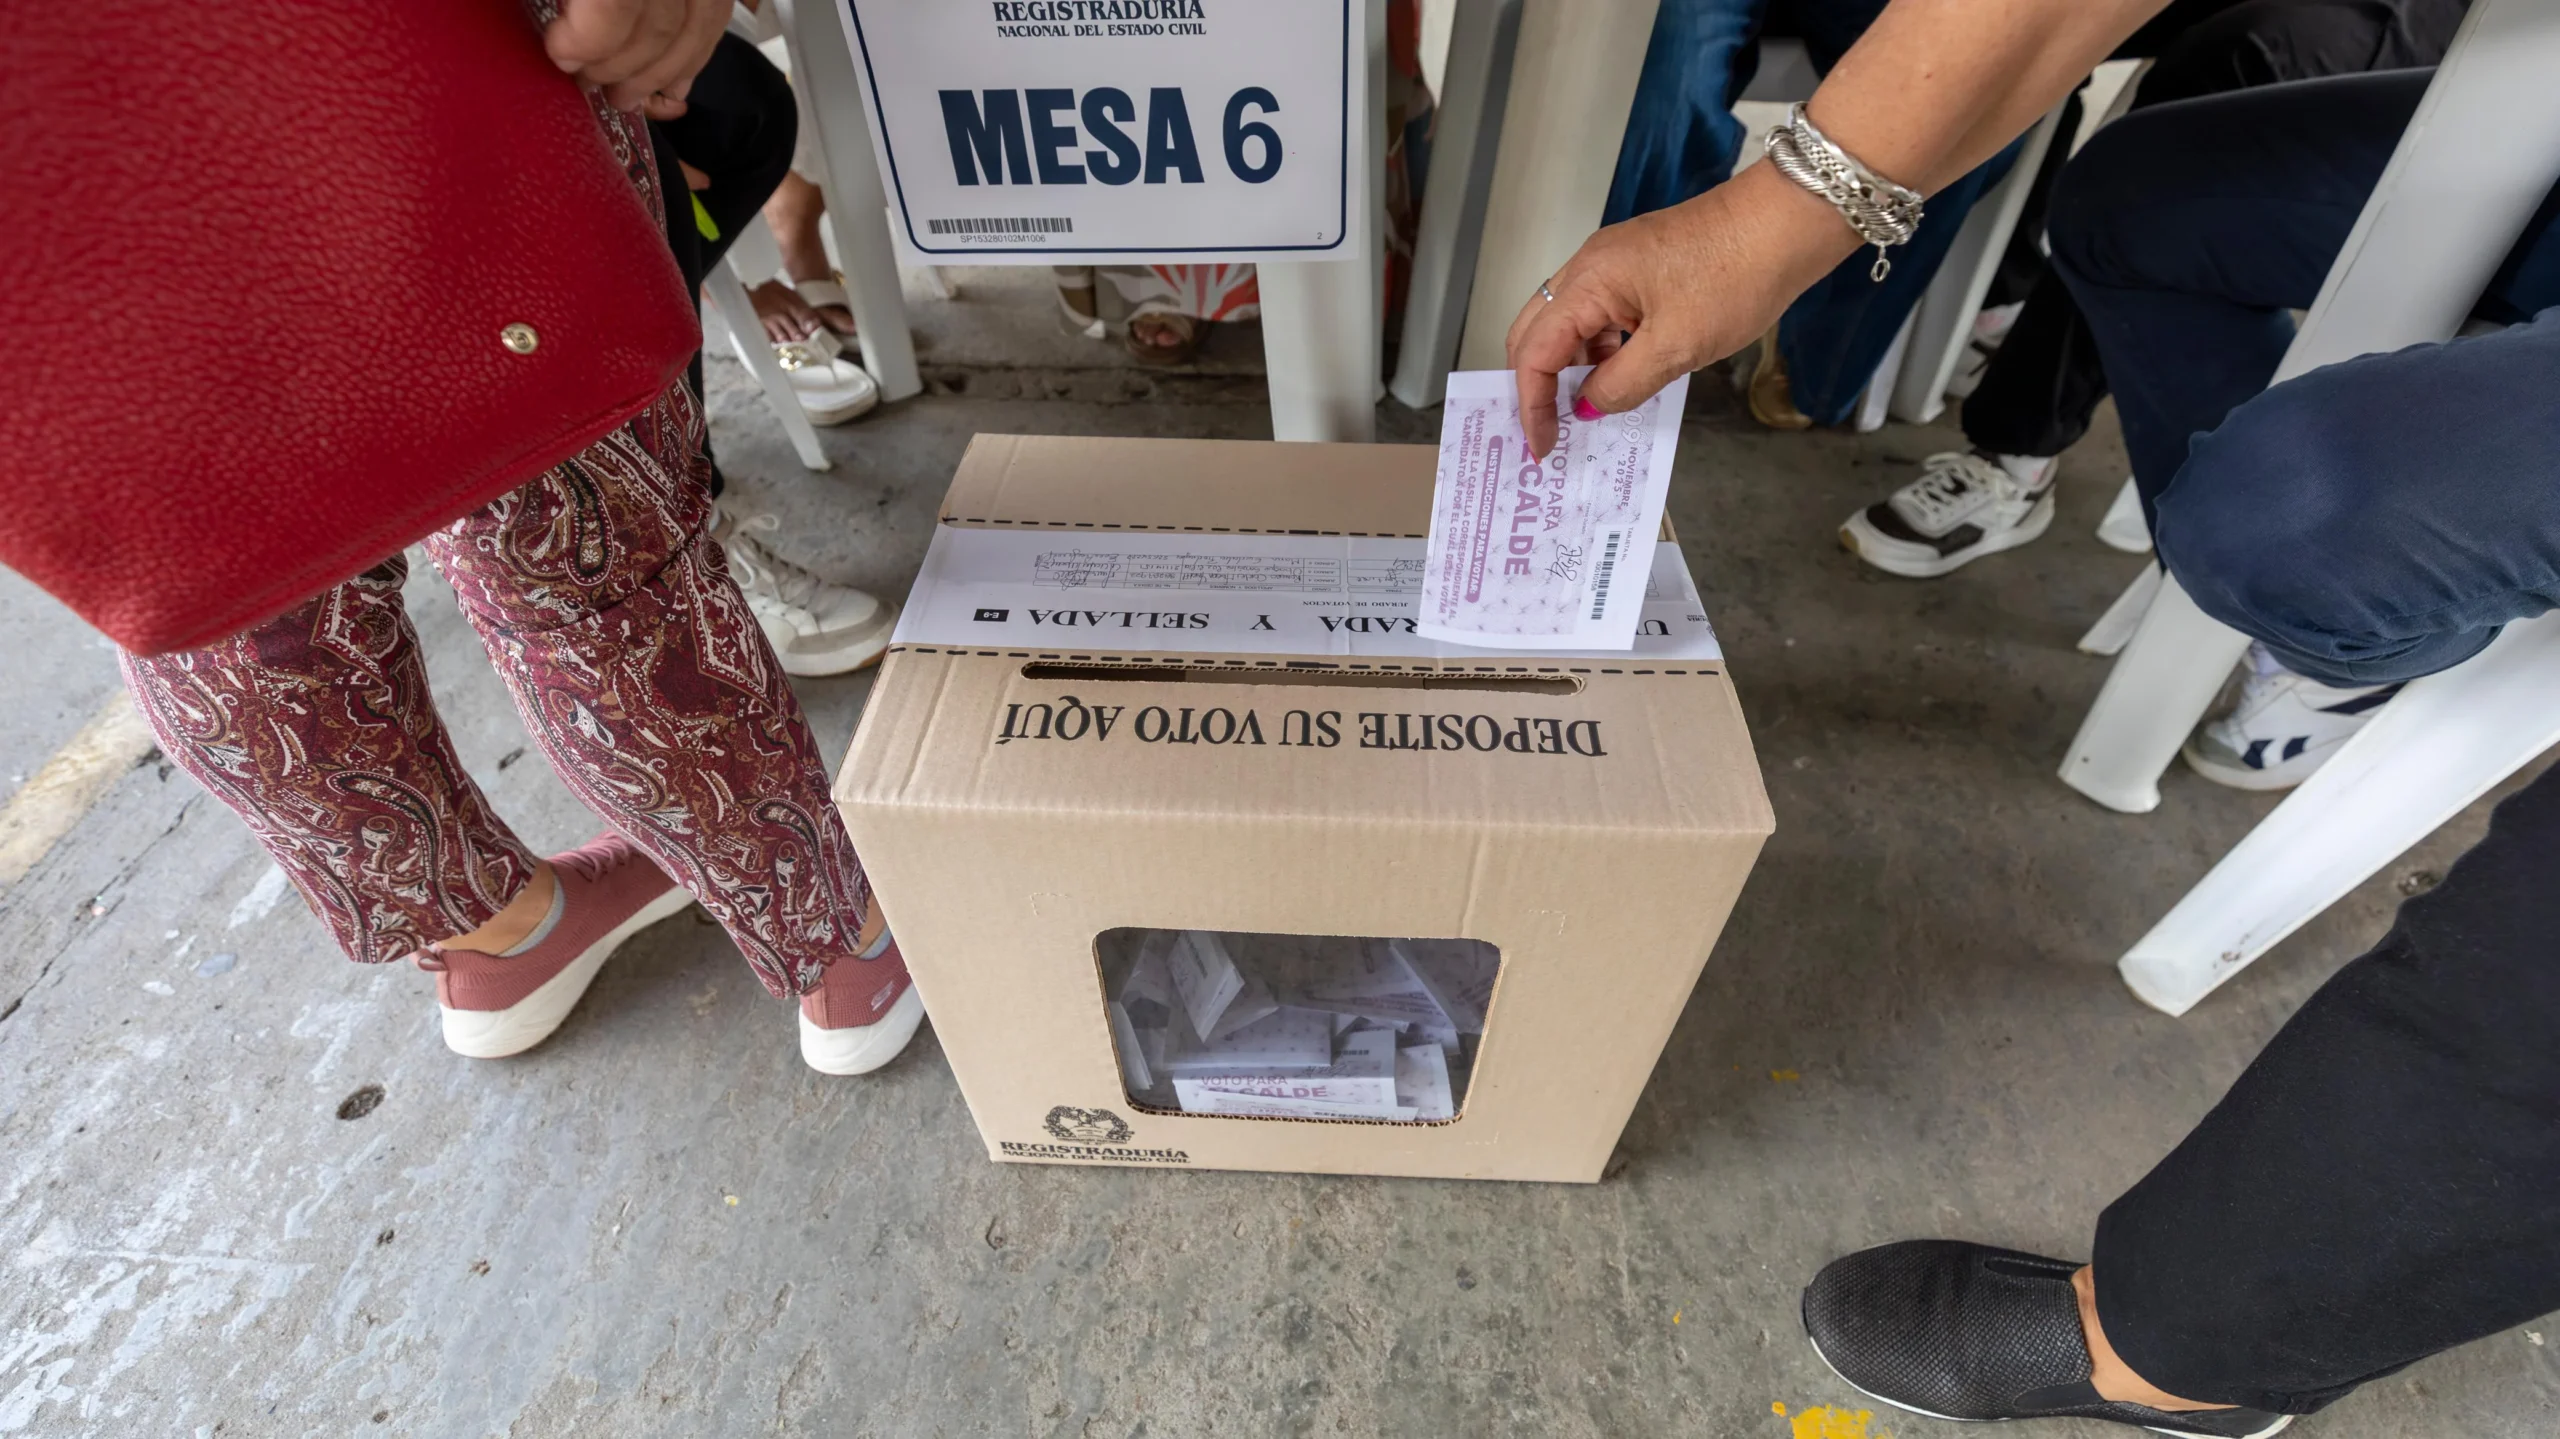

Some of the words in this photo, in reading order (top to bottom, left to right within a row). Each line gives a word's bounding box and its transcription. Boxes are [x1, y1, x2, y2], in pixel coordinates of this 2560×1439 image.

[996, 25, 1070, 38] NACIONAL
[1074, 25, 1104, 37] DEL
[1108, 24, 1164, 36] ESTADO
[1168, 23, 1207, 36] CIVIL
[937, 87, 1206, 187] MESA
[1222, 86, 1284, 185] 6
[1316, 231, 1323, 240] 2
[1472, 409, 1485, 457] MARQUE
[1551, 411, 1573, 471] VOTO
[1621, 411, 1644, 443] 09
[1457, 416, 1472, 478] CANDIDATO
[1586, 454, 1598, 462] 6
[1470, 460, 1479, 473] LA
[1620, 446, 1638, 507] NOVIEMBRE
[1452, 490, 1463, 510] POR
[1464, 476, 1477, 517] CASILLA
[1479, 447, 1499, 530] INSTRUCCIONES
[1504, 436, 1544, 575] CALDE
[1543, 477, 1566, 532] PARA
[1450, 513, 1460, 525] EL
[1447, 527, 1458, 552] CUAL
[1475, 533, 1487, 558] PARA
[1623, 526, 1634, 554] TARJETA
[1451, 520, 1471, 608] CORRESPONDIENTE
[983, 611, 1000, 619] E-9
[1027, 609, 1210, 629] SELLADA
[1249, 614, 1277, 631] Y
[1317, 615, 1420, 634] RADA
[995, 695, 1126, 745] AQUÍ
[1134, 706, 1267, 745] VOTO
[1278, 709, 1342, 748] SU
[1358, 712, 1608, 757] DEPOSITE
[1201, 1074, 1245, 1087] VOTO
[1247, 1075, 1289, 1086] PARA
[999, 1141, 1189, 1159] REGISTRADURÍA
[1002, 1150, 1065, 1160] NACIONAL
